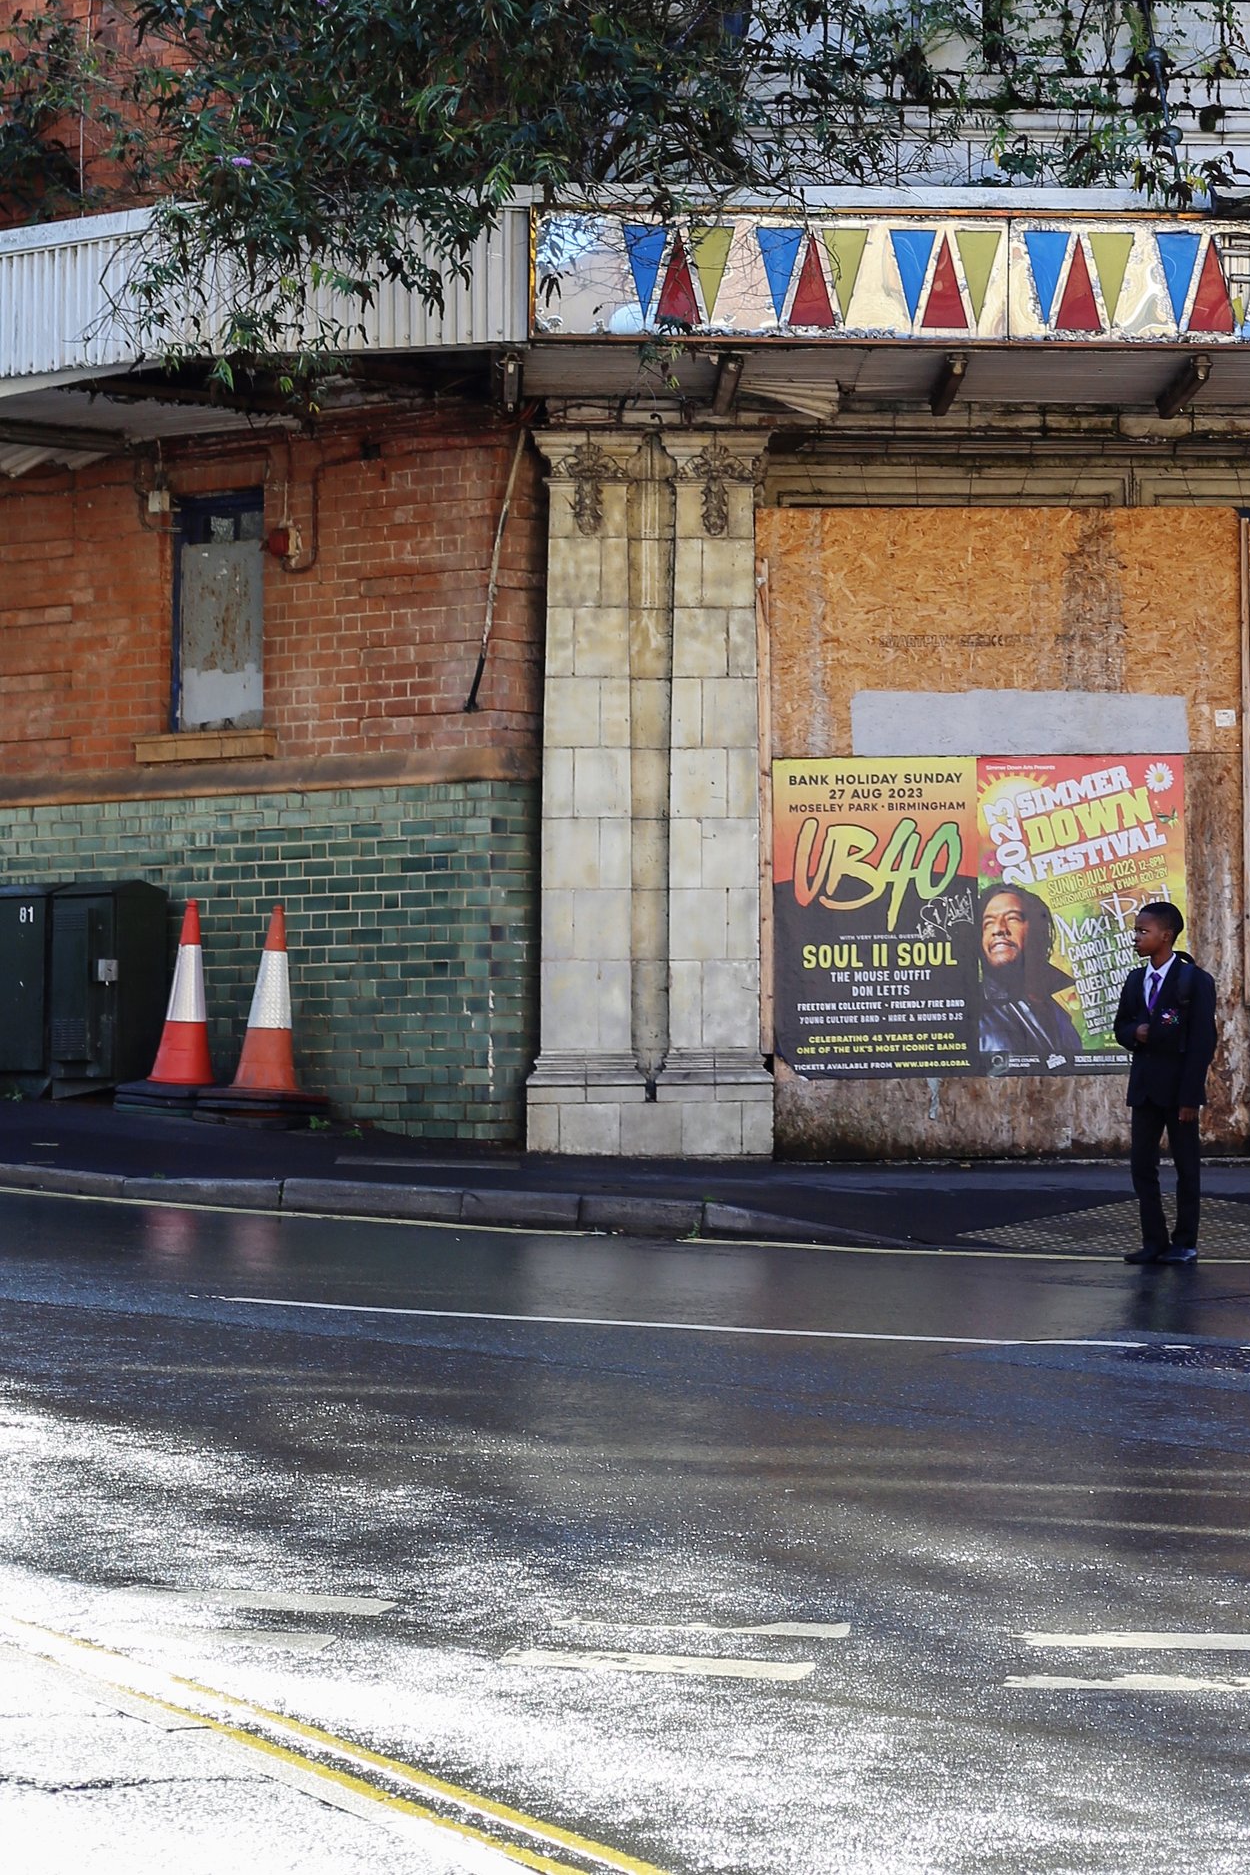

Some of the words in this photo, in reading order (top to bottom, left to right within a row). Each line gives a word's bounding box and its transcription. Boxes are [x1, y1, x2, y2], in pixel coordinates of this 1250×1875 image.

[789, 775, 829, 786] BANK
[835, 774, 898, 785] HOLIDAY
[904, 773, 963, 784] SUNDAY
[829, 789, 846, 800] 27
[851, 788, 882, 799] AUG
[888, 788, 923, 799] 2023
[1015, 765, 1132, 818] SIMMER
[789, 804, 844, 813] MOSELEY
[849, 803, 878, 812] PARK
[888, 802, 966, 811] BIRMINGHAM
[1022, 786, 1154, 855] DOWN
[983, 797, 1035, 885] 2023
[1031, 822, 1167, 882] FESTIVAL
[793, 817, 962, 932] UB40
[1047, 876, 1071, 896] SUN
[1085, 866, 1107, 885] JULY
[1109, 859, 1137, 879] 2023
[1050, 887, 1097, 909] HANDSWORTH
[1098, 882, 1117, 897] PARK
[19, 906, 34, 923] 81
[802, 944, 864, 969] SOUL
[897, 942, 958, 966] SOUL
[1067, 936, 1115, 963] CARROLL
[1071, 963, 1082, 979] &
[1082, 954, 1113, 976] JANET
[1114, 947, 1135, 967] KAY
[831, 972, 850, 982] THE
[854, 971, 890, 982] MOUSE
[894, 970, 931, 981] OUTFIT
[1075, 975, 1109, 995] QUEEN
[852, 986, 873, 997] DON
[877, 985, 910, 996] LETTS
[1080, 989, 1103, 1009] JAZZ
[797, 1003, 836, 1011] FREETOWN
[838, 1002, 882, 1011] COLLECTIVE
[891, 1001, 926, 1009] FRIENDLY
[928, 1000, 944, 1008] FIRE
[946, 1000, 965, 1008] BAND
[799, 1016, 824, 1025] YOUNG
[826, 1016, 858, 1024] CULTURE
[860, 1015, 880, 1023] BAND
[888, 1014, 907, 1022] HARE
[909, 1014, 916, 1022] &
[917, 1013, 947, 1021] HOUNDS
[949, 1013, 963, 1021] DJS
[808, 1035, 870, 1044] CELEBRATING
[872, 1034, 883, 1042] 45
[884, 1033, 914, 1042] YEARS
[916, 1033, 928, 1041] OF
[931, 1032, 955, 1041] UB40
[796, 1046, 816, 1055] ONE
[818, 1046, 831, 1054] OF
[834, 1045, 850, 1054] THE
[852, 1045, 873, 1053] UK'S
[875, 1044, 900, 1053] MOST
[902, 1044, 935, 1052] ICONIC
[937, 1042, 967, 1051] BANDS
[794, 1063, 825, 1071] TICKETS
[826, 1062, 868, 1070] AVAILABLE
[894, 1059, 971, 1068] WWW.UB40.GLOBAL
